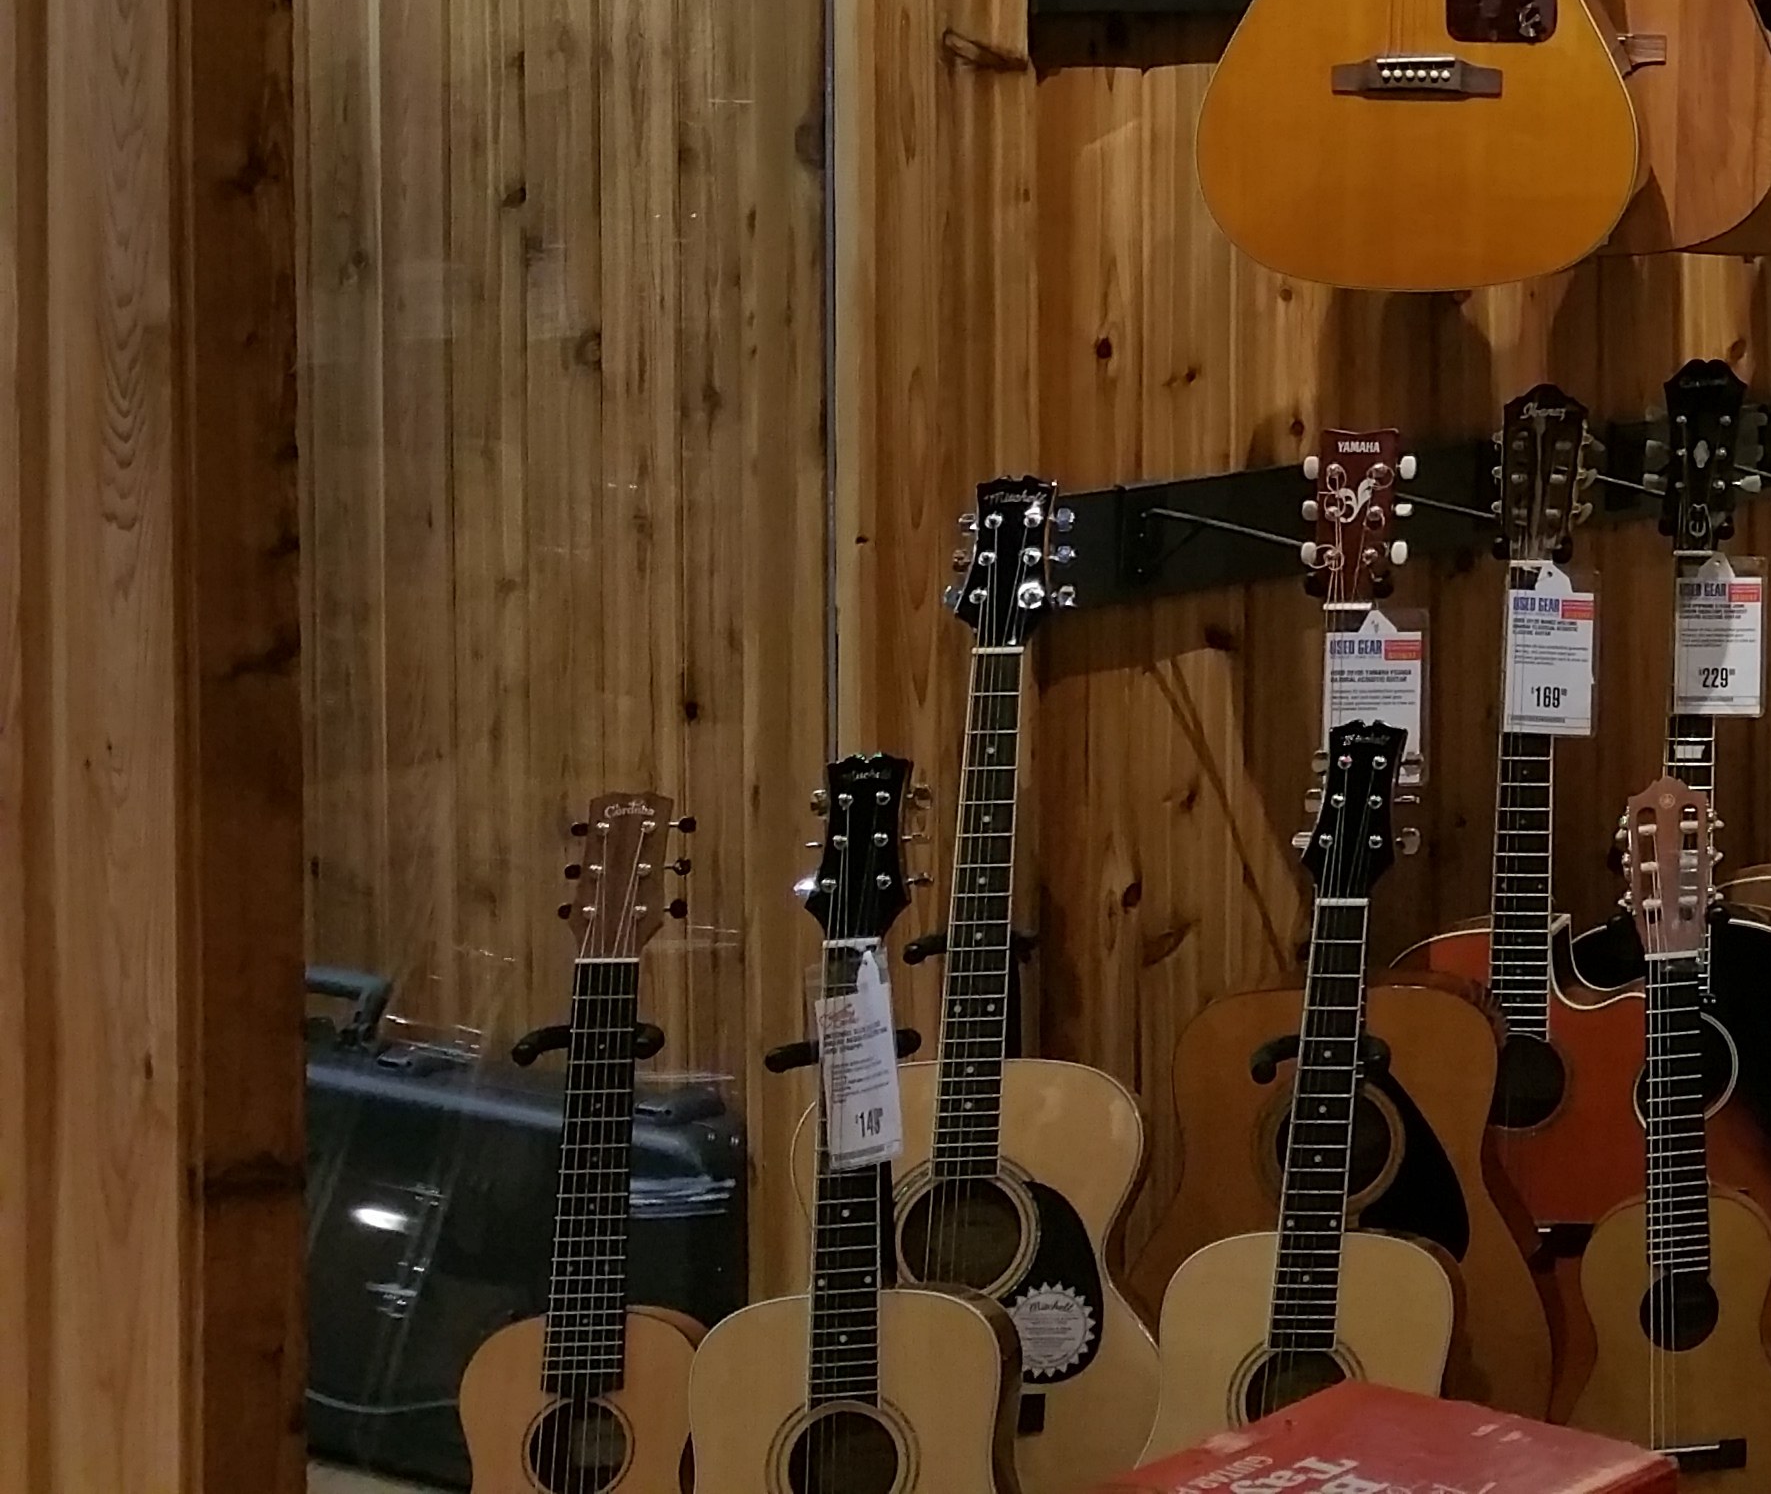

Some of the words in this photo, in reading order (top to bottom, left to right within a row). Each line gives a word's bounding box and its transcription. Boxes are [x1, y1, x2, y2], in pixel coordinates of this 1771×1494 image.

[1337, 441, 1381, 454] YAMAHA
[1704, 583, 1726, 596] GEAR
[1514, 597, 1535, 611] USED
[1539, 598, 1560, 612] GEAR
[1330, 639, 1355, 655] USED
[1358, 639, 1382, 655] GEAR
